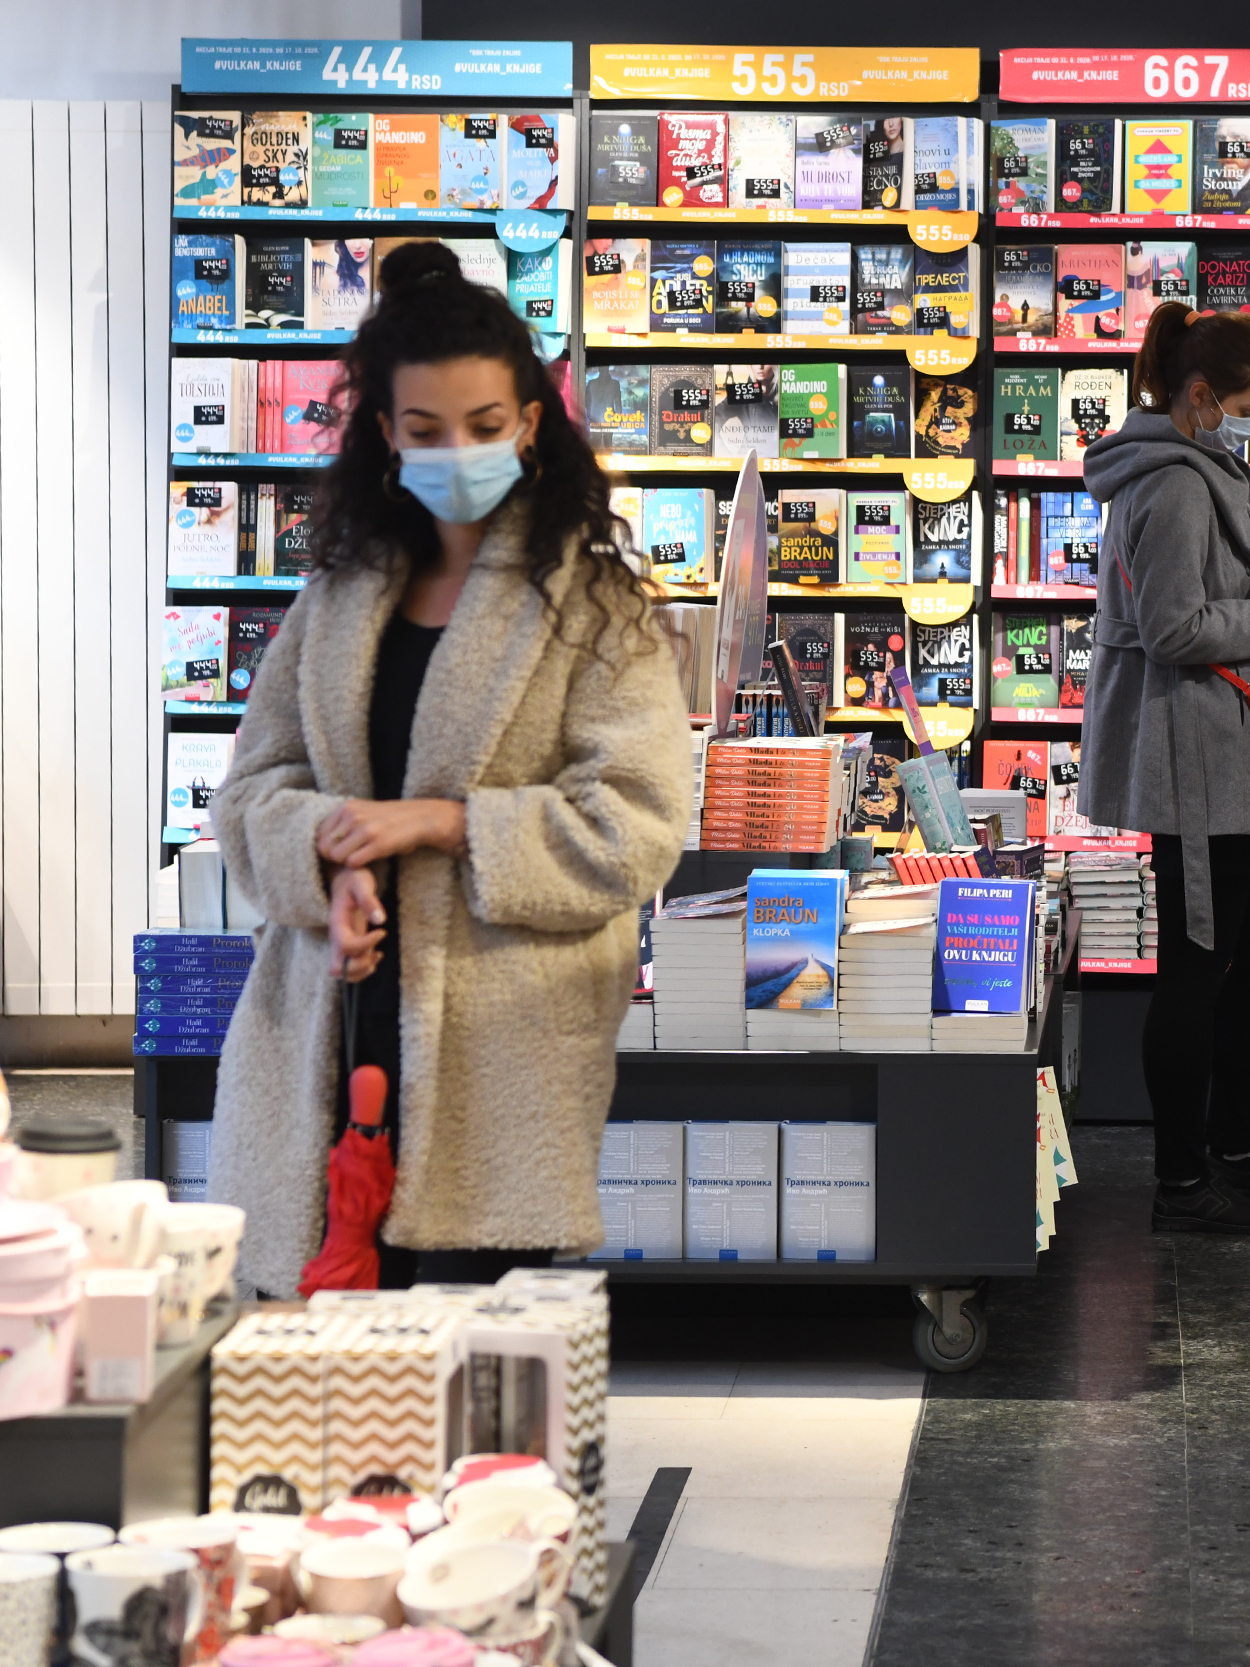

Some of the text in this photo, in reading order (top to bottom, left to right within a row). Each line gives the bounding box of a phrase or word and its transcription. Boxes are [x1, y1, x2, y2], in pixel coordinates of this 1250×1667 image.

[214, 60, 301, 72] #VULKAN_KNJIGE
[322, 46, 441, 90] 444 RSD
[455, 63, 542, 75] #VULKAN_KNJIGE
[623, 67, 710, 79] #VULKAN_KNJIGE
[731, 53, 849, 97] 555 RSD
[862, 70, 949, 81] #VULKAN_KNJIGE
[1032, 70, 1118, 82] #VULKAN_KNJIGE
[1143, 55, 1229, 98] 667
[376, 119, 390, 131] OG
[668, 121, 711, 139] Pesma
[251, 131, 299, 146] GOLDEN
[376, 131, 426, 144] MANDINO
[678, 139, 706, 150] moje
[263, 148, 288, 163] SKY
[322, 153, 363, 165] ŽABICA
[443, 149, 496, 162] AGATA
[512, 148, 555, 158] MOLITVA
[801, 171, 852, 183] MUDROST
[1202, 165, 1244, 179] Irving
[1202, 178, 1242, 190] Stoun
[503, 222, 559, 240] 444 RSD
[915, 225, 970, 241] 555 RSD
[175, 239, 188, 247] LINA
[796, 254, 835, 265] Dečak
[516, 271, 553, 283] ZADOBITI
[674, 273, 692, 281] JUSI
[732, 264, 765, 280] SRCU
[916, 273, 965, 286] ПРЕЛЕСТ
[1207, 273, 1247, 287] KARIZI
[178, 295, 229, 314] ANABEL
[321, 297, 358, 306] SUTRA
[593, 301, 639, 310] MRAKA?
[1206, 294, 1248, 305] LAVIRINTA
[781, 369, 796, 383] OG
[178, 382, 227, 399] TOLSTOJA
[781, 380, 827, 394] MANDINO
[1000, 384, 1052, 397] HRAM
[1074, 379, 1113, 392] ROĐEN
[603, 408, 645, 423] Čovek
[661, 410, 701, 423] Drakul
[1002, 435, 1048, 450] LOŽA
[660, 504, 682, 517] NEBO
[917, 501, 969, 520] STEPHEN
[675, 529, 697, 543] NAMA
[919, 516, 970, 543] KING
[781, 535, 822, 548] sandra
[780, 546, 834, 562] BRAUN
[780, 559, 830, 569] IDOL NACIJE
[1005, 617, 1047, 630] STEPHEN
[916, 626, 969, 644] STEPHEN
[1006, 626, 1047, 646] KING
[918, 639, 971, 666] KING
[182, 743, 217, 753] KRAVA
[175, 758, 222, 769] PLAKALA
[958, 887, 1012, 898] FILIPA PERI
[754, 895, 803, 907] sandra
[753, 908, 818, 924] BRAUN
[947, 913, 1020, 925] DA SU SAMO
[753, 928, 791, 937] KLOPKA
[947, 924, 1018, 936] VAŠI RODITELJI
[174, 944, 205, 953] Džubran
[181, 937, 251, 949] Halil Prorok
[945, 935, 1017, 950] PROČITALI
[944, 949, 1017, 962] OVU KNJIGU
[174, 964, 205, 973] Džubran
[687, 1177, 772, 1188] Травничка хроника
[785, 1177, 870, 1188] Травничка хроника
[688, 1187, 730, 1195] Иво Андрић
[786, 1187, 828, 1195] Иво Андрић
